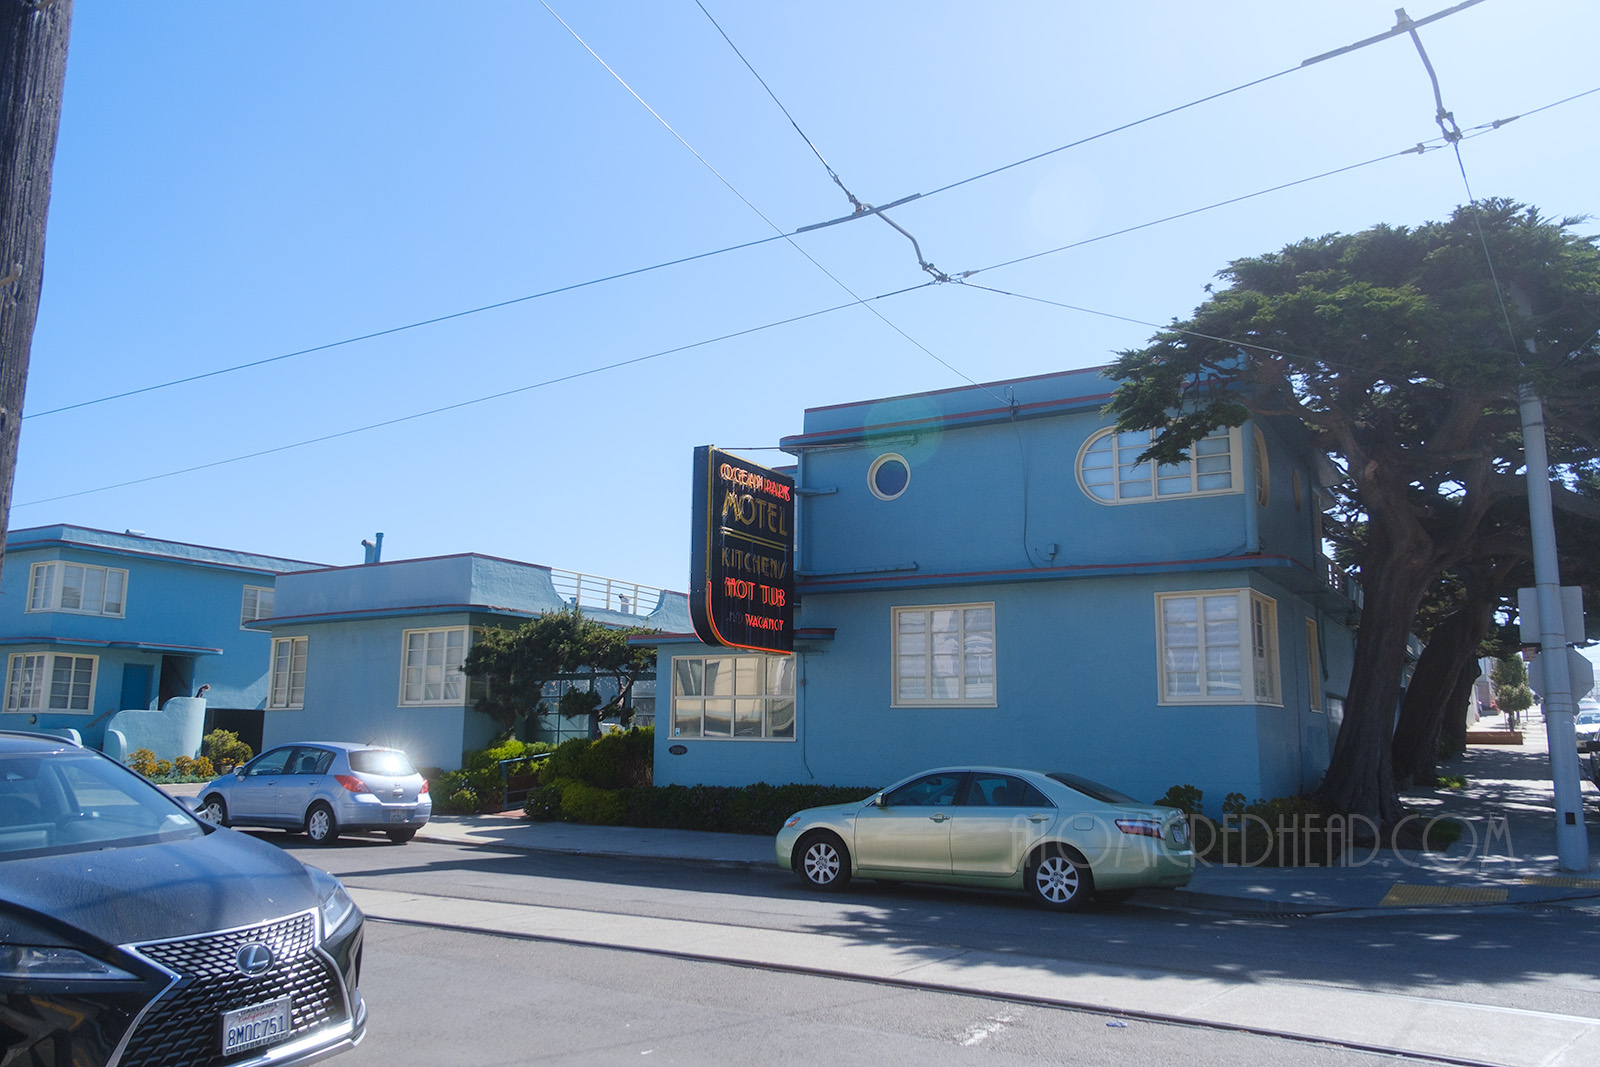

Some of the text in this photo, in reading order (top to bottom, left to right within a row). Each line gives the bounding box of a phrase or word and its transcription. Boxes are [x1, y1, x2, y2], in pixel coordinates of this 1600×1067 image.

[720, 463, 791, 502] OCEAN PARK
[721, 488, 788, 536] MOTEL
[721, 546, 788, 580] KITCHENS
[724, 576, 786, 607] HOT TUB
[745, 612, 785, 631] VACANCY
